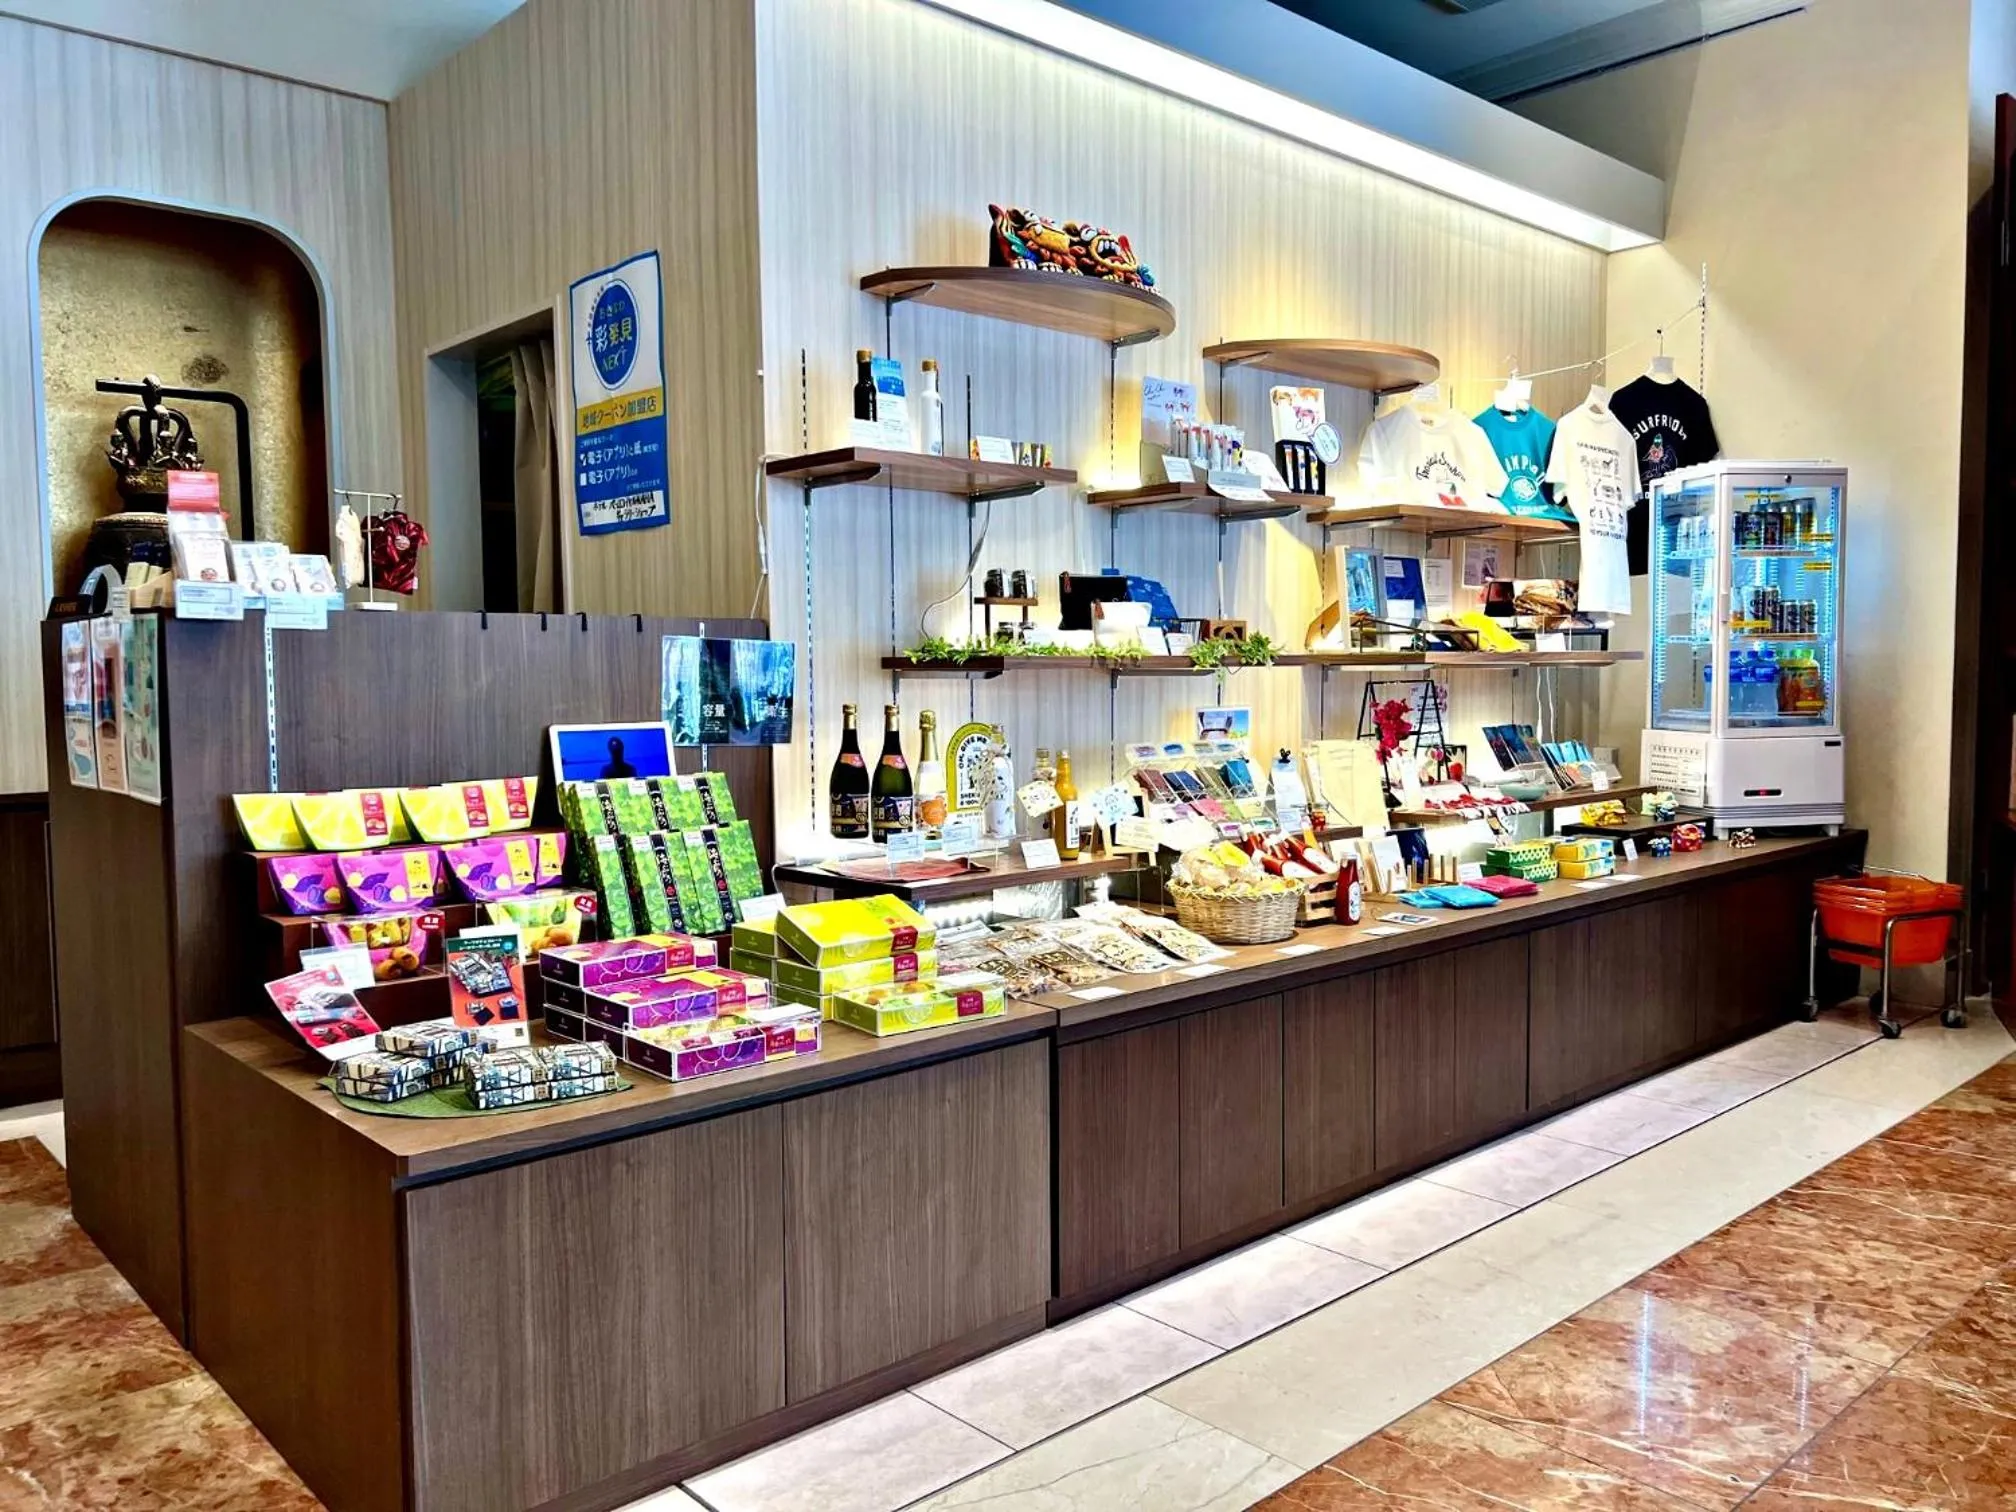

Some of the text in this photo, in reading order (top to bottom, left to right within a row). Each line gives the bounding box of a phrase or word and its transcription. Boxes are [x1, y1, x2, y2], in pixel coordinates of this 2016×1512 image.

[595, 317, 633, 353] 彩発見
[602, 346, 627, 373] NEXT
